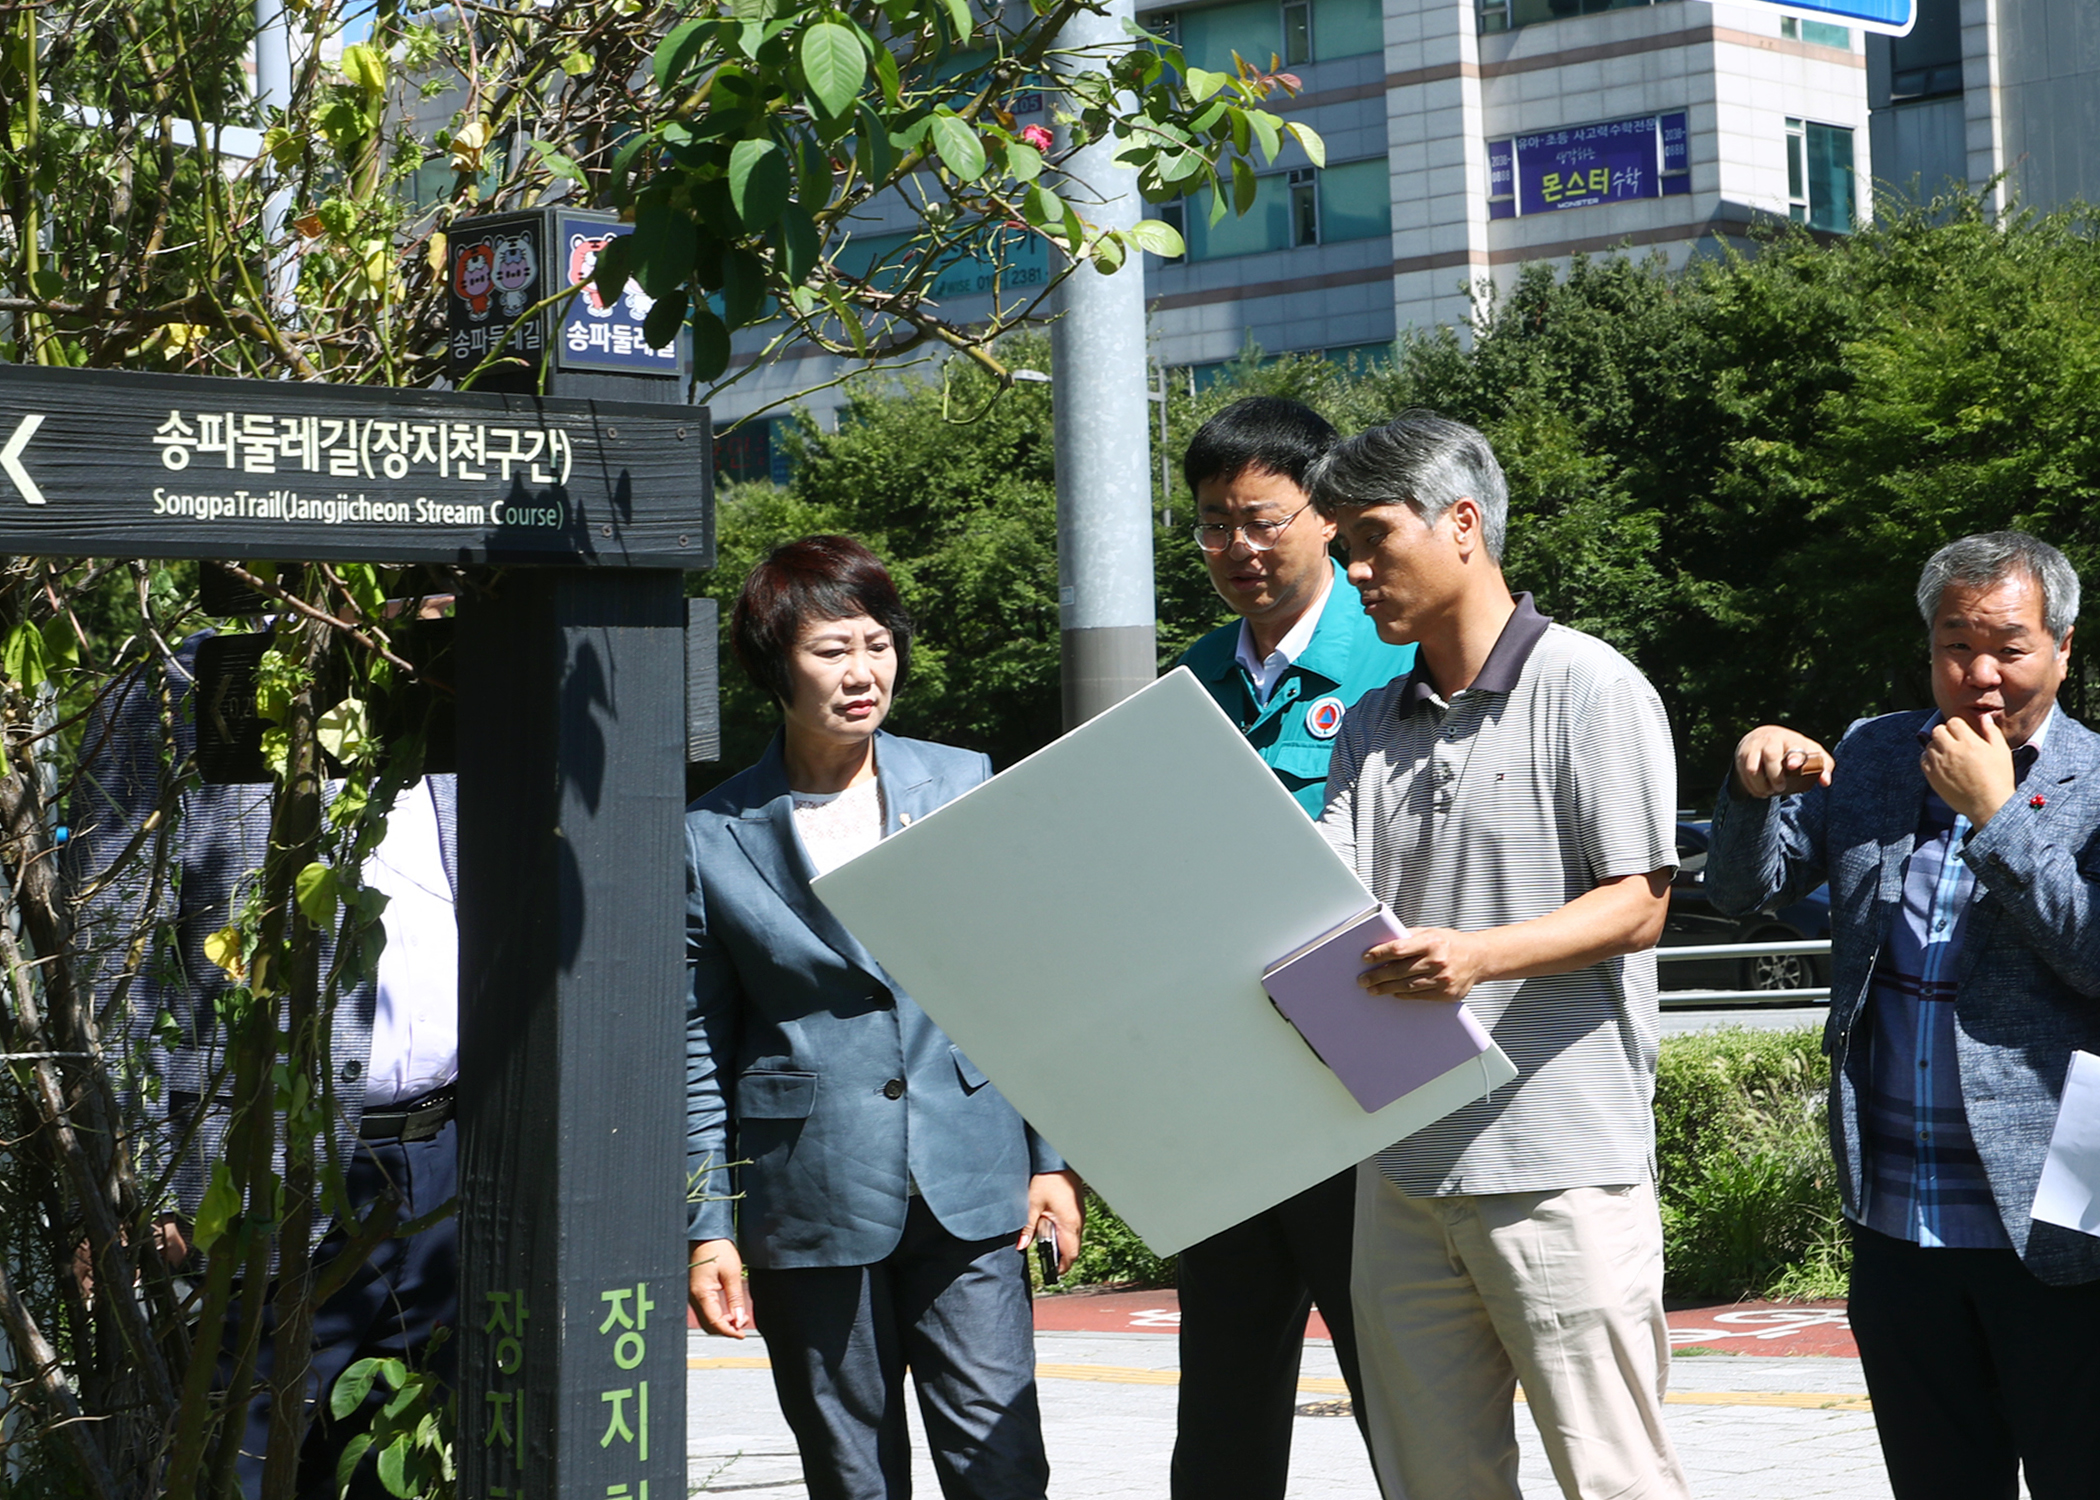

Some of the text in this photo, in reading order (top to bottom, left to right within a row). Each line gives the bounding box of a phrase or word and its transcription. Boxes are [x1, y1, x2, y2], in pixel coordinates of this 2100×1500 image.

[1542, 166, 1643, 203] 몬스터 수학
[1557, 197, 1600, 209] MONSTER
[152, 409, 572, 487] 송파둘레길(장지천구간)
[152, 487, 565, 530] SongpaTrail(Jangjicheon Stream Course)
[484, 1288, 530, 1500] 장지
[598, 1282, 655, 1500] 장지
